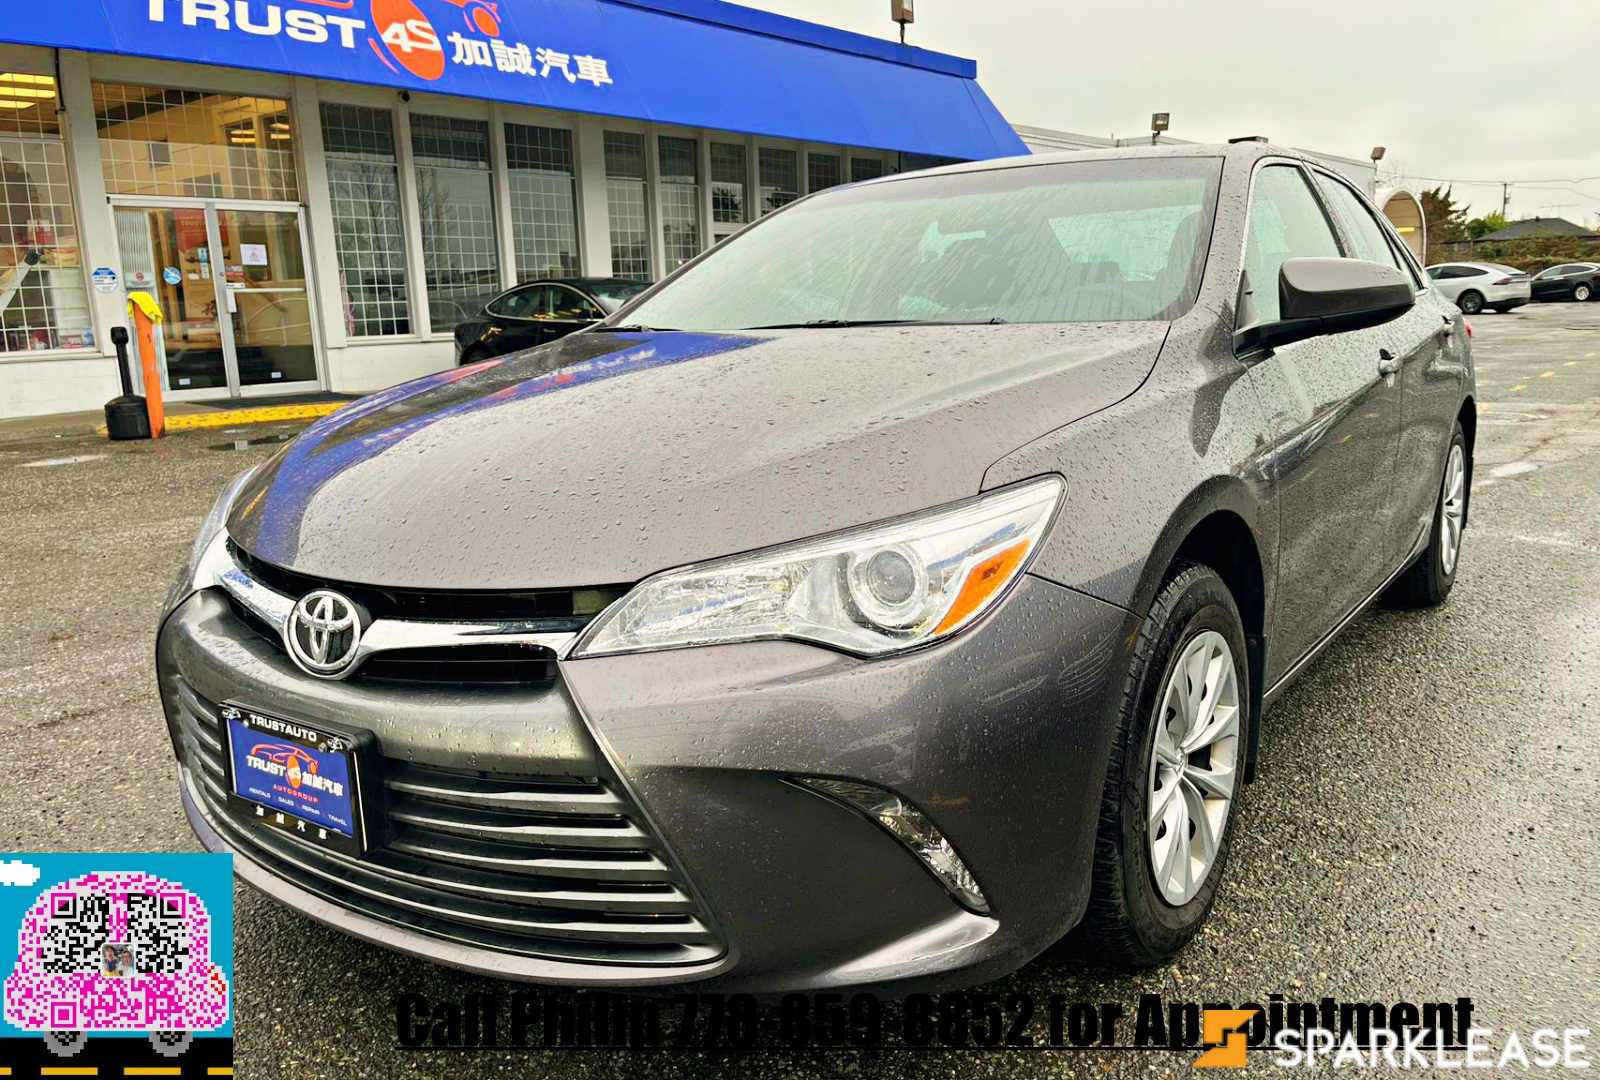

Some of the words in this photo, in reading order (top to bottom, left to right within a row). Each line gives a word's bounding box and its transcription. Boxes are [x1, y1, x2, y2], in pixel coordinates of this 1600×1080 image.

[381, 18, 442, 52] 4S
[447, 31, 613, 86] 加誠汽車
[250, 714, 317, 742] TRUSTAUTO
[246, 755, 286, 777] TRUST
